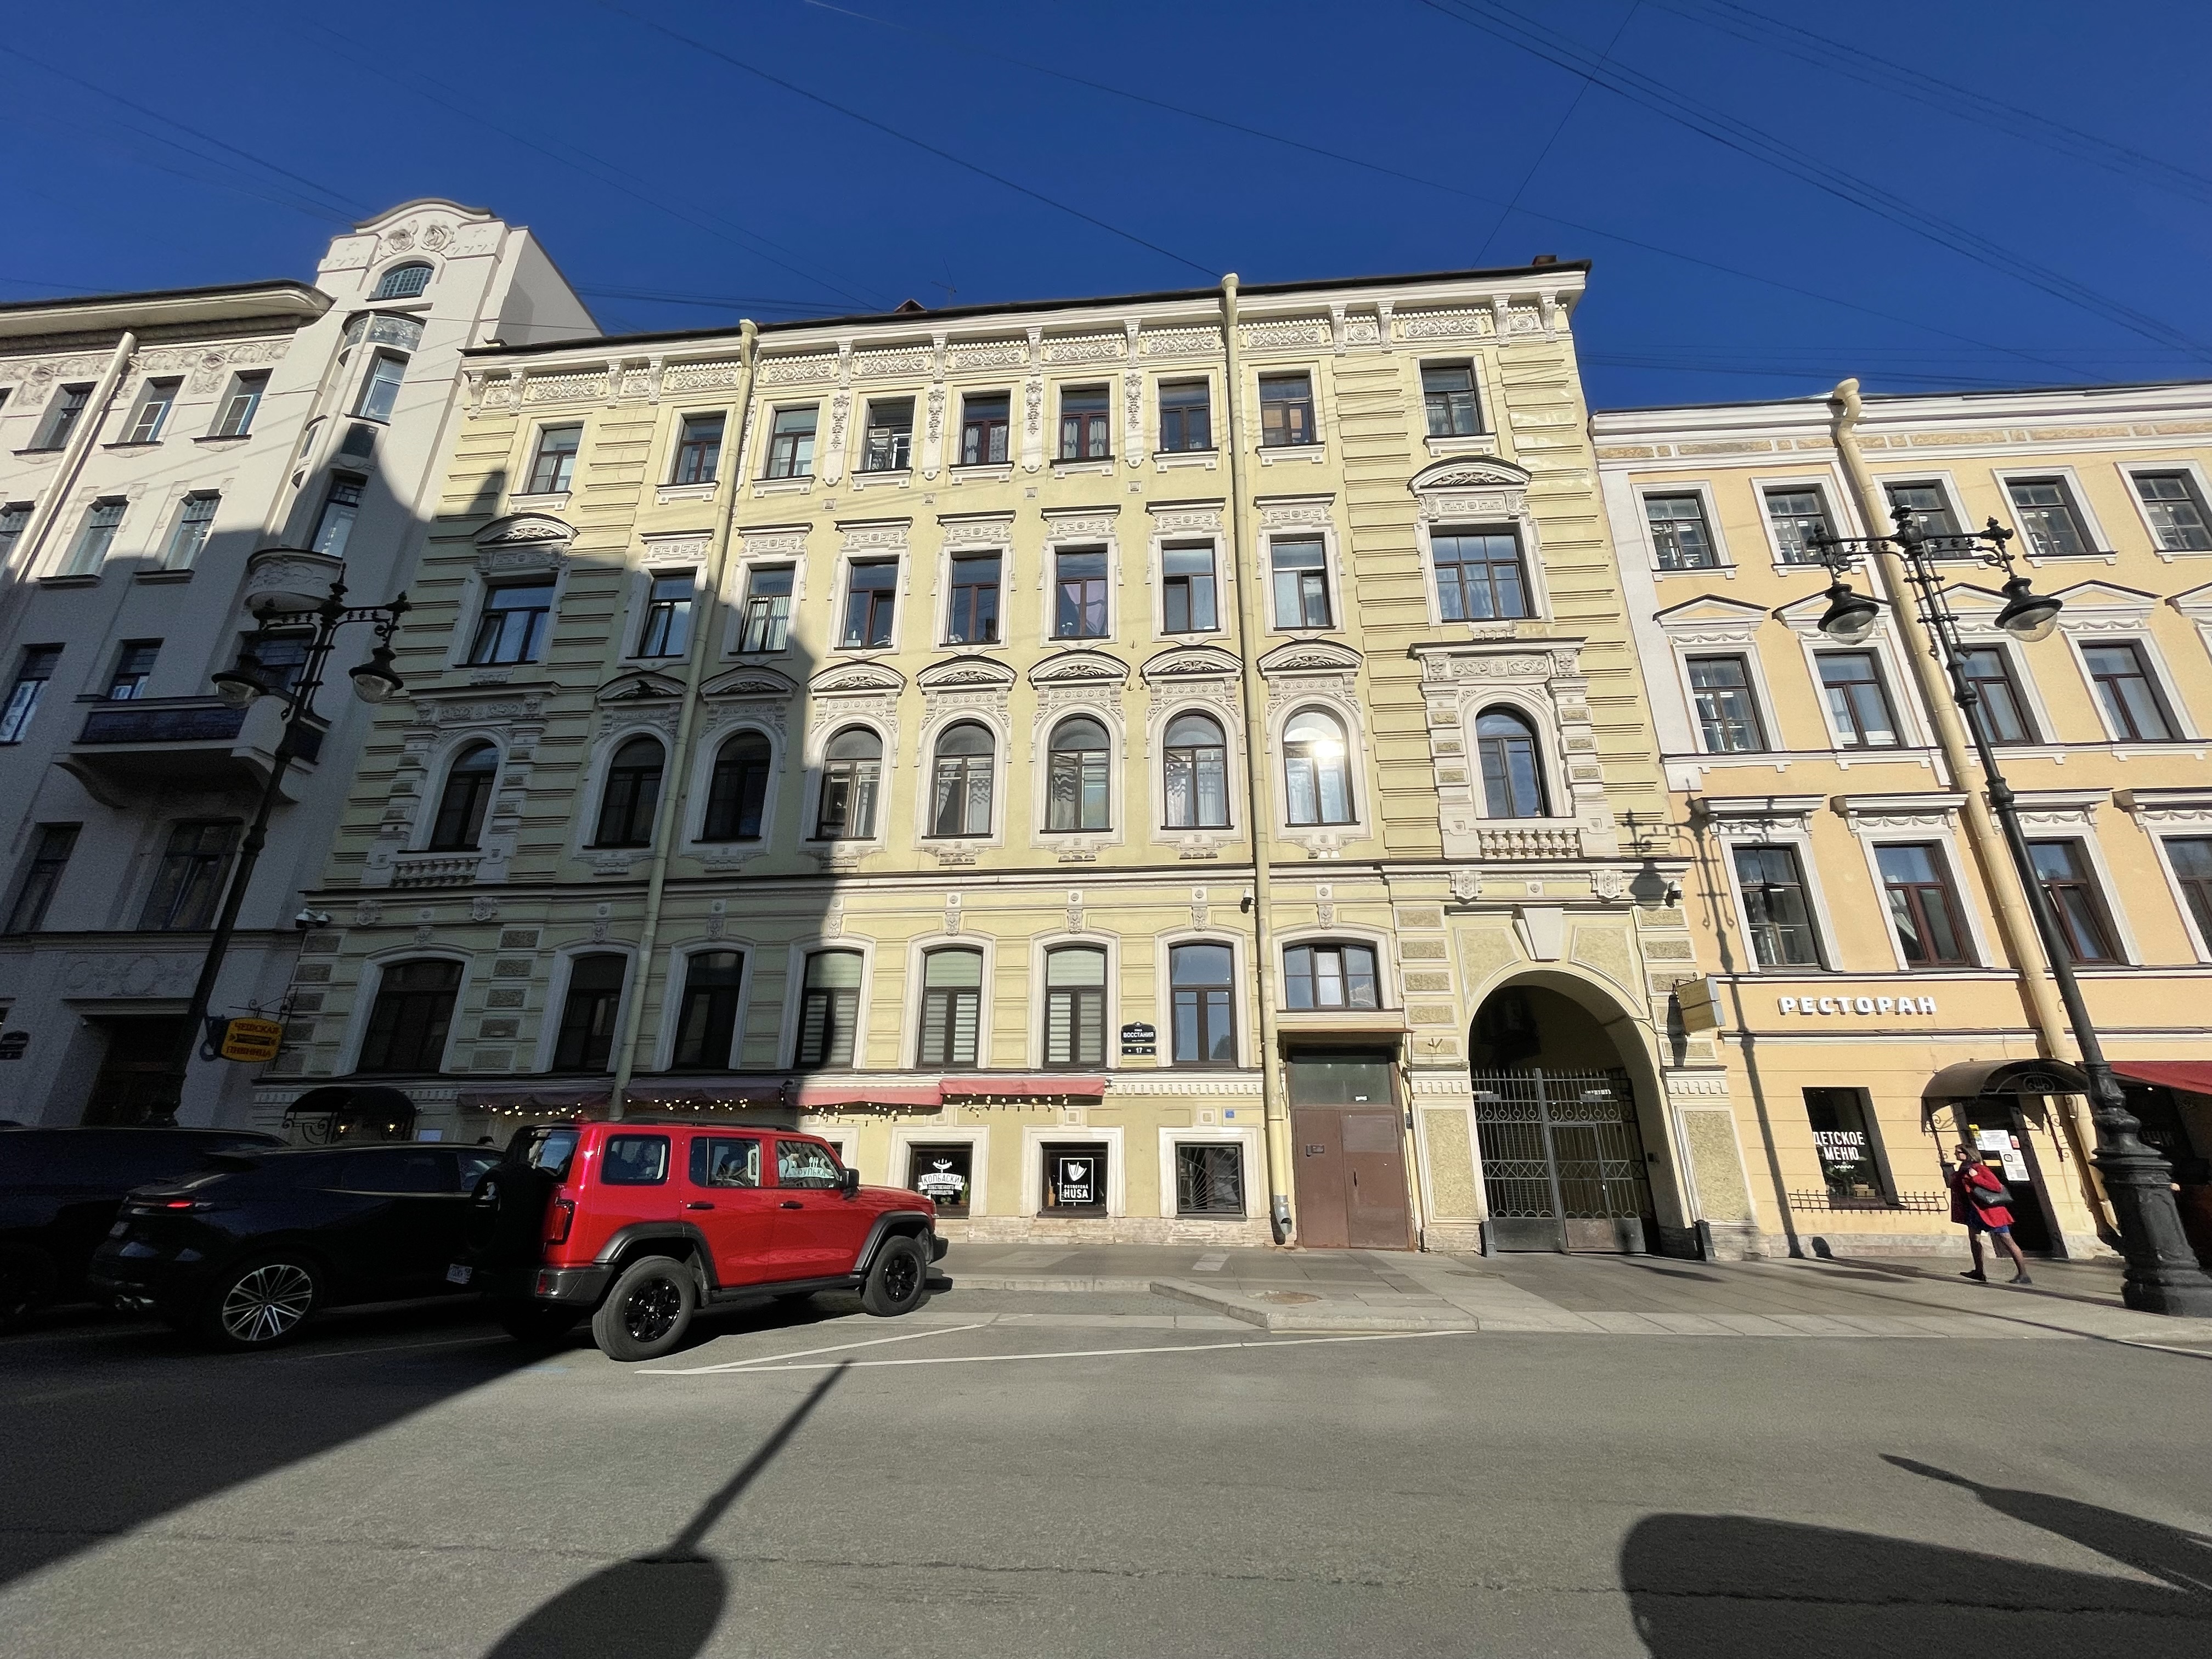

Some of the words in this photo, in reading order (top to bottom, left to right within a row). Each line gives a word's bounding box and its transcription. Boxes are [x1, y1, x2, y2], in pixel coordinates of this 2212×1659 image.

[1779, 996, 1937, 1014] РЕСТОРАН
[234, 1022, 279, 1035] ЧЕШСКАЯ
[1812, 1131, 1865, 1147] ДЕТСКОЕ
[1824, 1146, 1859, 1160] МЕНЮ
[923, 1173, 960, 1184] КОЛБАСКИ
[1064, 1189, 1089, 1199] HUSA
